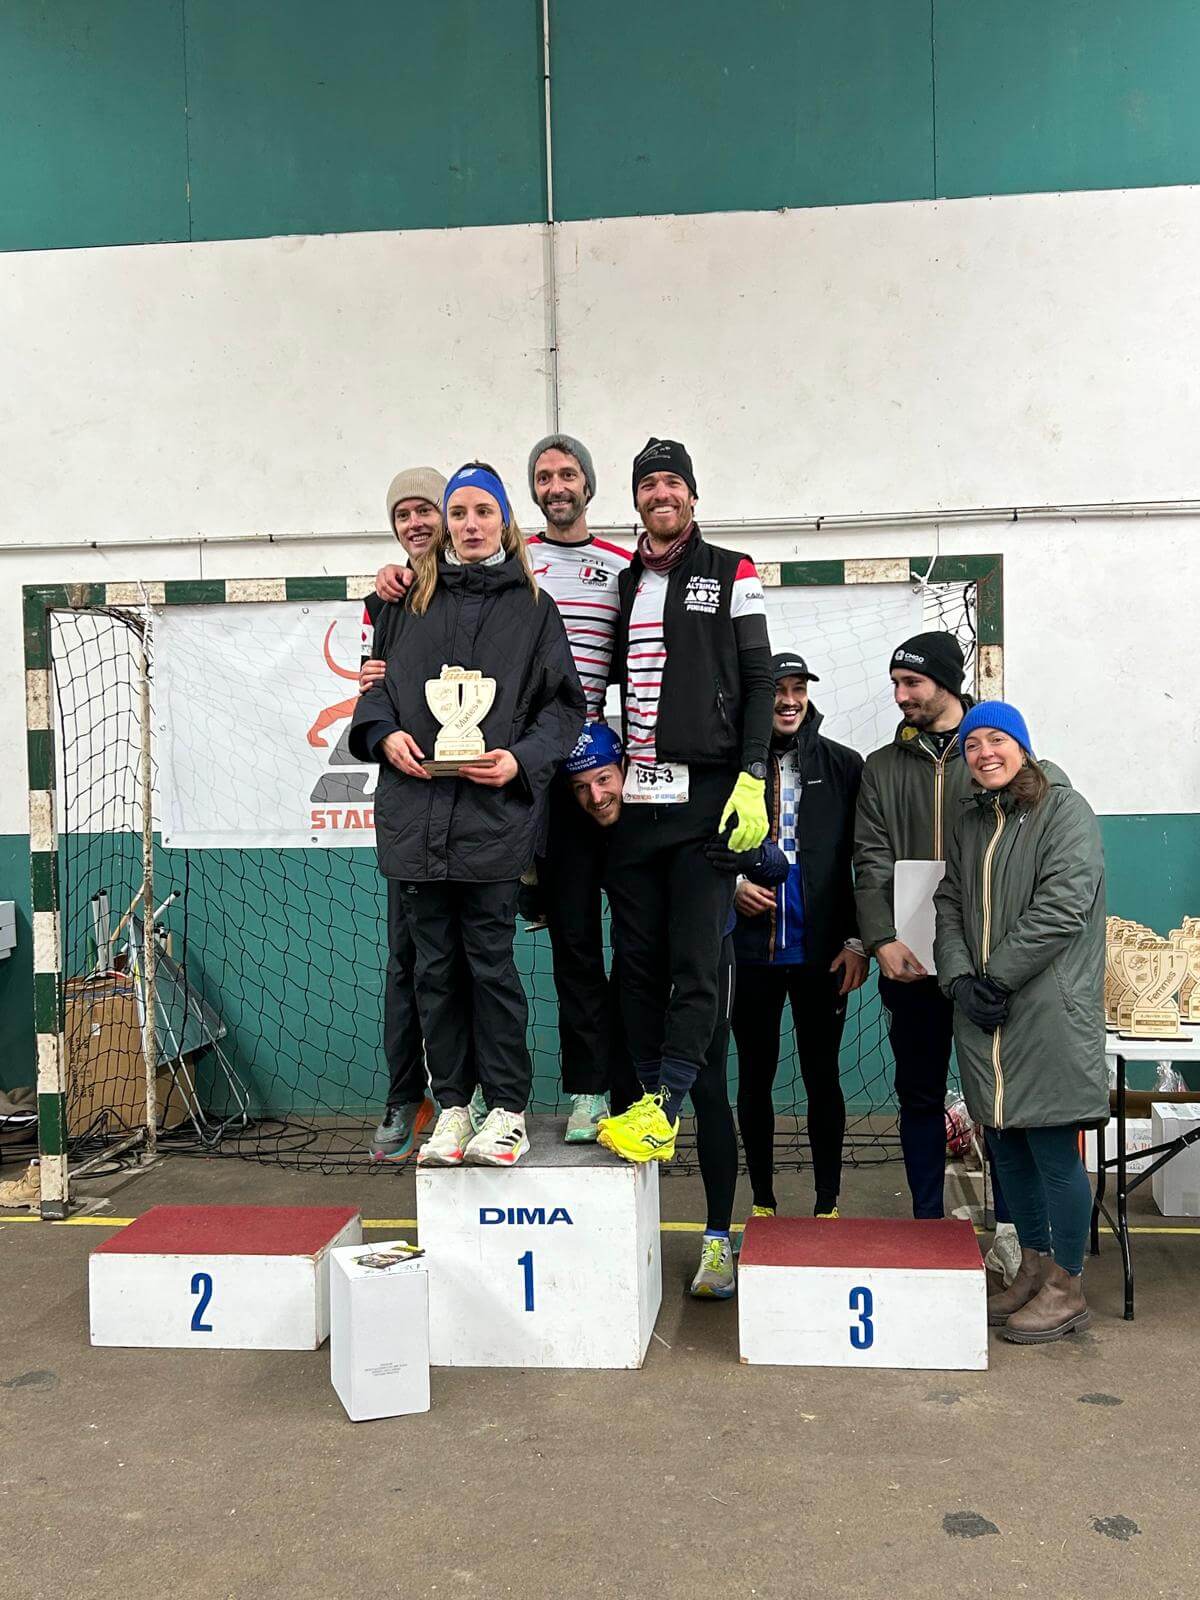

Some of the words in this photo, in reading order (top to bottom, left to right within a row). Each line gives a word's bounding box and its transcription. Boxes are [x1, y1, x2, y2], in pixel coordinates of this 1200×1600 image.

[1146, 970, 1177, 1004] Femmes
[479, 1207, 574, 1225] DIMA
[190, 1272, 213, 1332] 2
[517, 1250, 535, 1312] 1
[849, 1286, 874, 1350] 3
